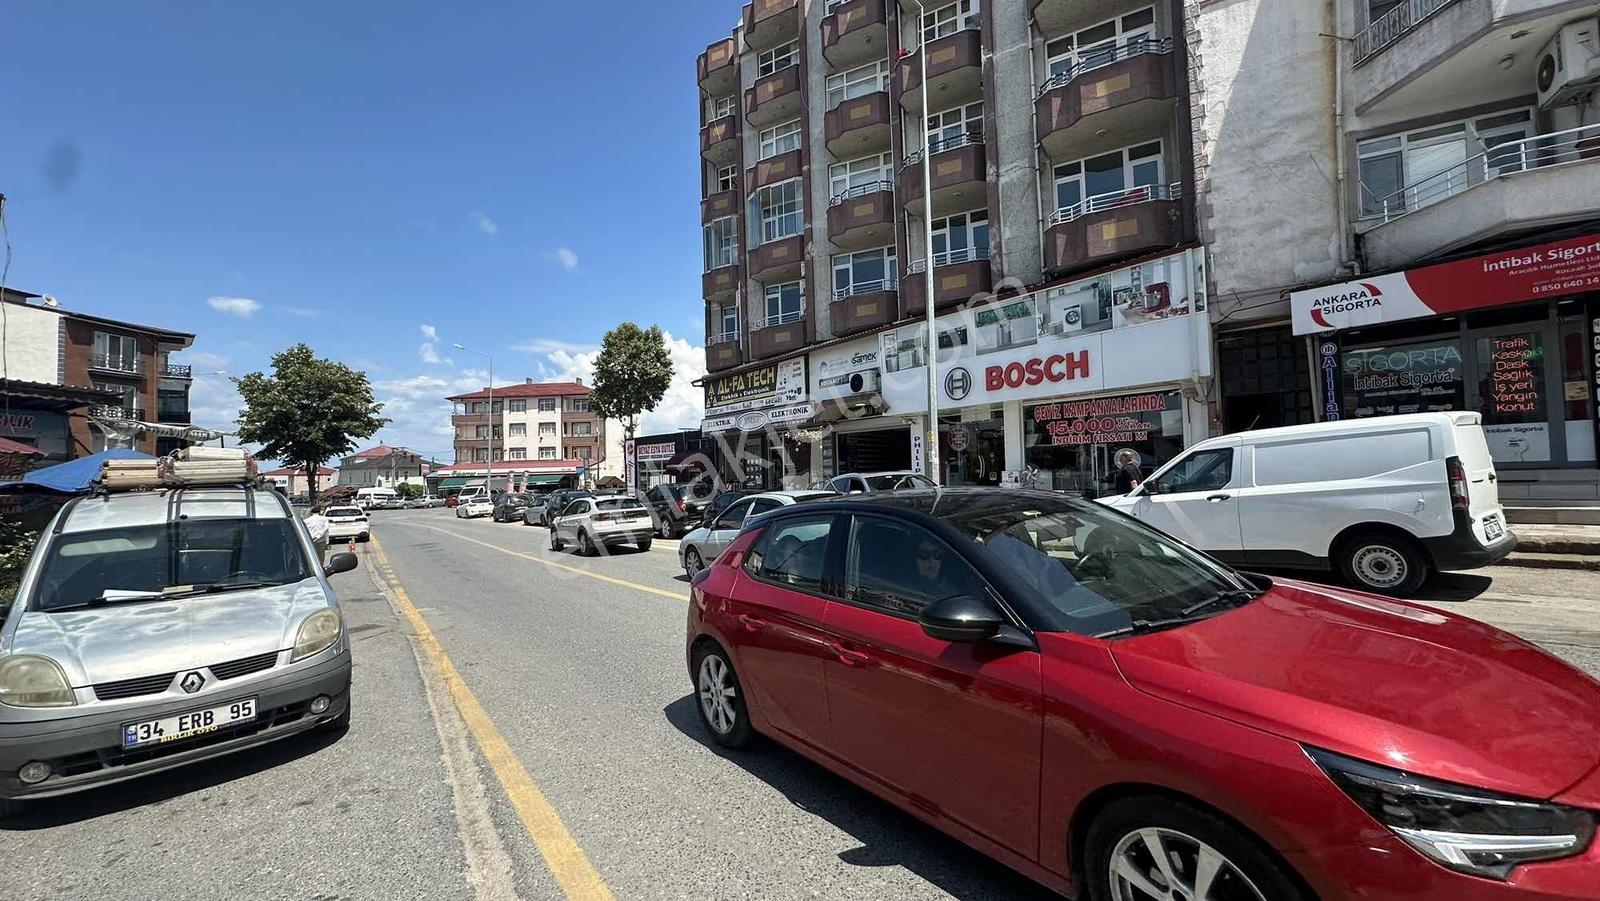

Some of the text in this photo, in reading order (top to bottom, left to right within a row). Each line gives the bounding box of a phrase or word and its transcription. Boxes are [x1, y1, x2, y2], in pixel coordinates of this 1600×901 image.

[1483, 252, 1541, 272] İntibak
[1541, 283, 1561, 292] 850
[1563, 279, 1583, 288] 640
[1586, 276, 1599, 284] 14
[1313, 290, 1368, 307] ANKARA
[1493, 337, 1529, 349] Trafik
[985, 350, 1090, 391] BOSCH
[1496, 360, 1529, 371] Dask
[747, 366, 775, 388] TECH
[1400, 368, 1453, 388] Sigorta
[1509, 379, 1533, 391] yeri
[1492, 391, 1537, 402] Yangın
[1063, 394, 1166, 418] KAMPANYALARINDA
[1496, 402, 1535, 412] Konut
[1046, 416, 1116, 436] 15.000
[1052, 432, 1092, 446] İNDİRİM
[139, 722, 164, 740] 34
[178, 710, 214, 732] ERB
[230, 701, 251, 720] 95
